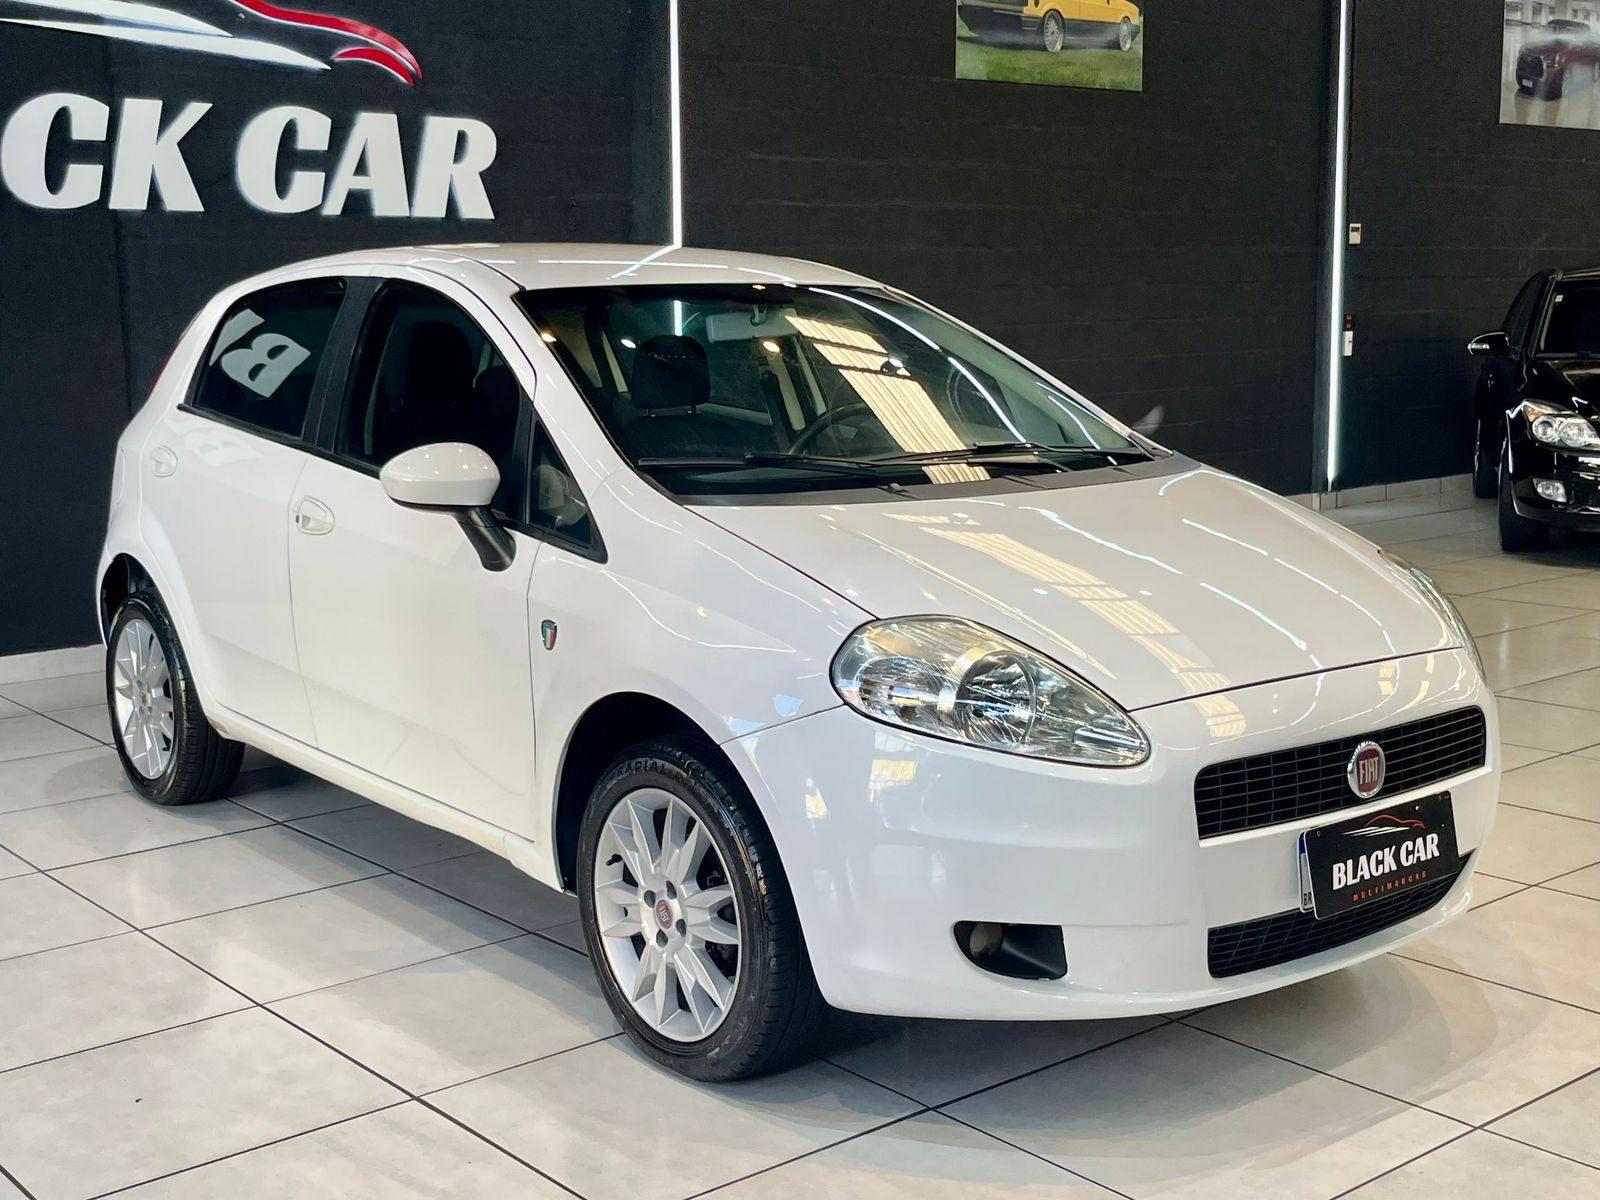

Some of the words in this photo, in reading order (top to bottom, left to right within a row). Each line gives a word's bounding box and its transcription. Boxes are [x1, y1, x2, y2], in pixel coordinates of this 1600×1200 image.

[1, 92, 213, 212] CK
[236, 104, 497, 220] CAR
[1358, 756, 1379, 785] FIAT
[1332, 845, 1398, 891] BLACK
[1399, 833, 1440, 867] CAR
